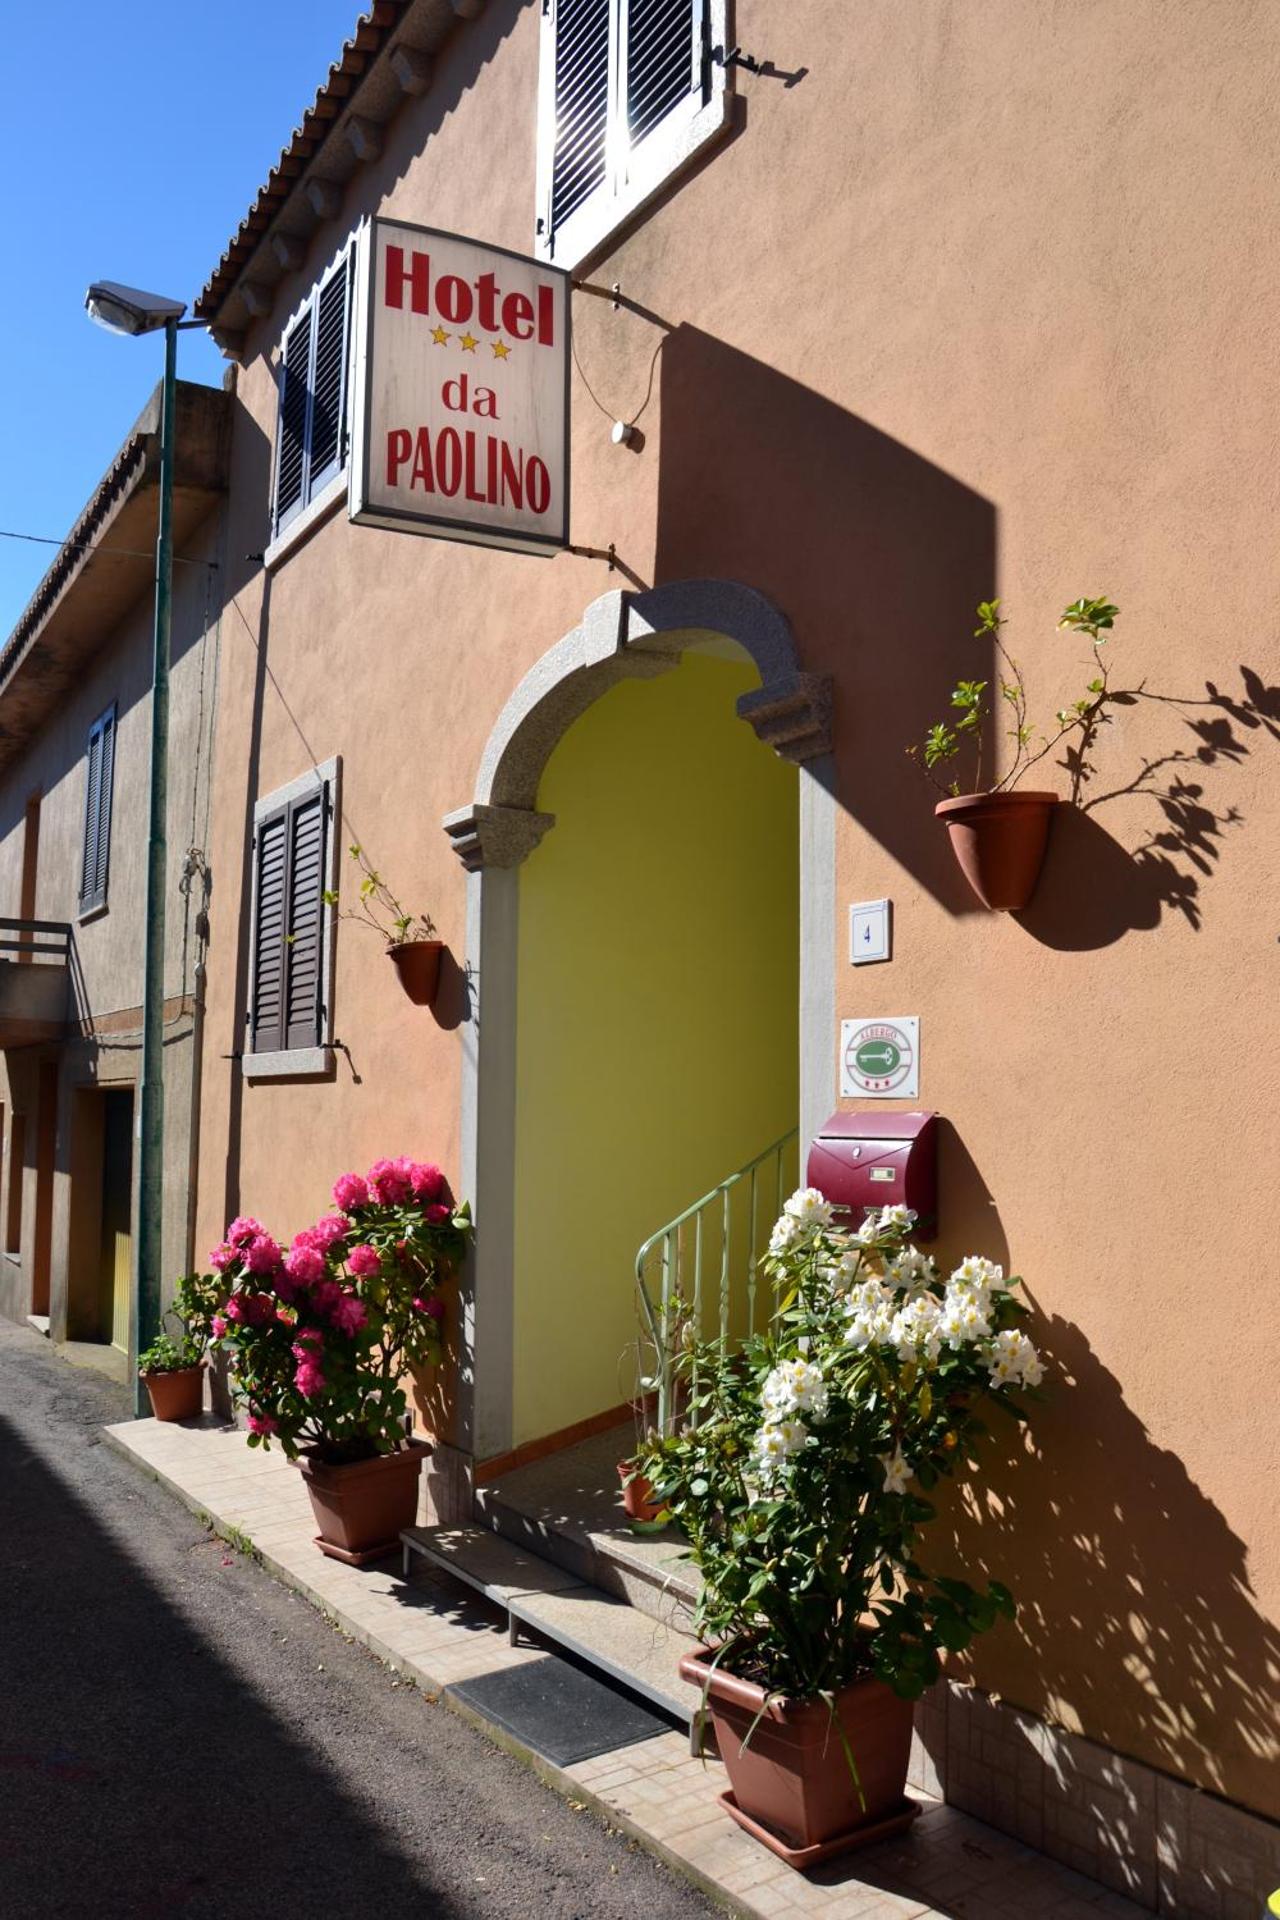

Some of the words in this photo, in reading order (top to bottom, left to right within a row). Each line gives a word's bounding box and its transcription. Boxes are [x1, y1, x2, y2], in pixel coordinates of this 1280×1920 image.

[384, 244, 554, 347] Hotel
[441, 373, 500, 420] da
[386, 426, 551, 514] PAOLINO
[864, 924, 871, 943] 4
[861, 1027, 897, 1039] ALBERGO
